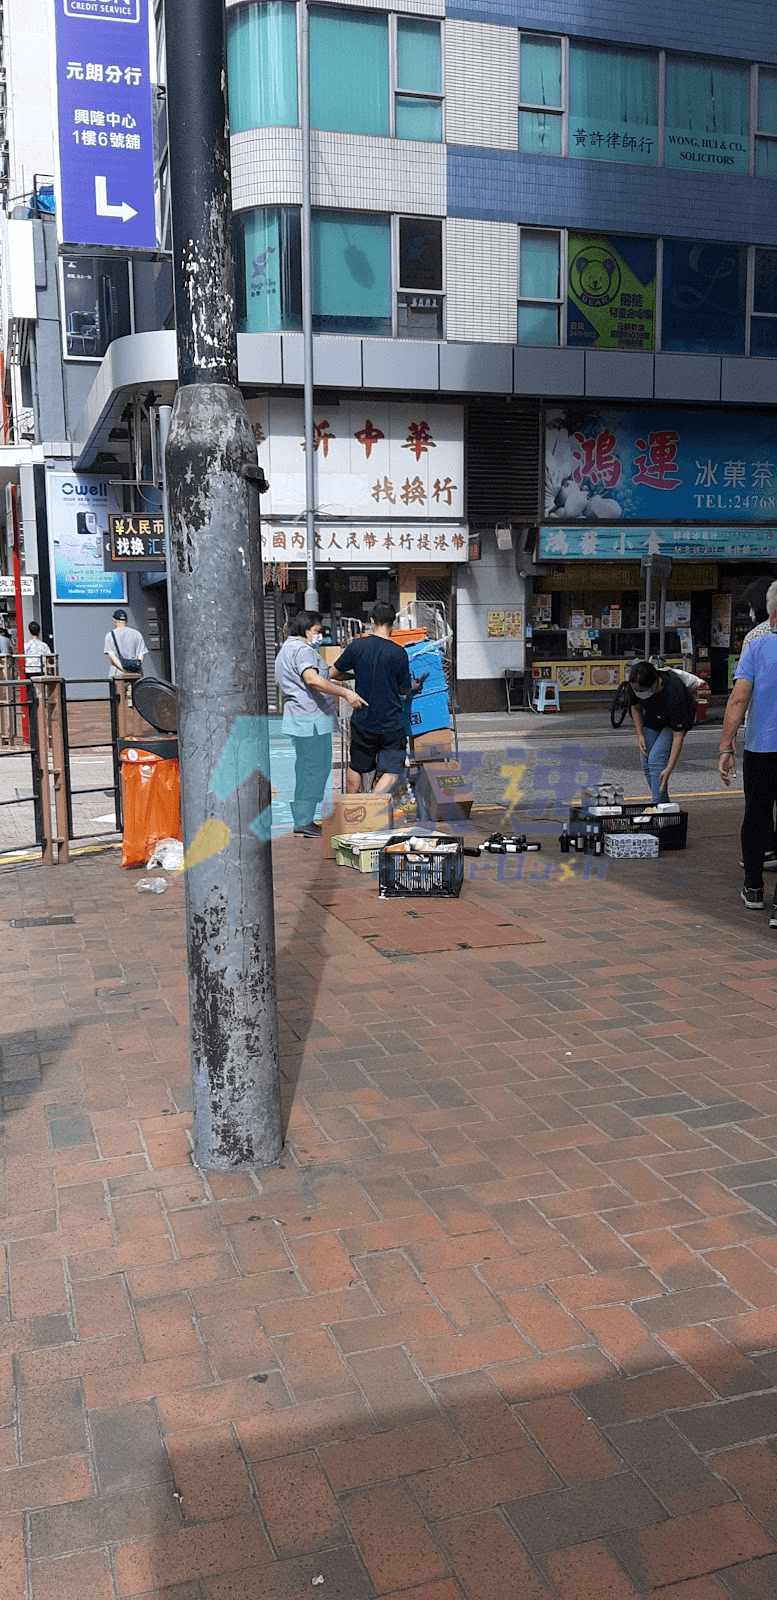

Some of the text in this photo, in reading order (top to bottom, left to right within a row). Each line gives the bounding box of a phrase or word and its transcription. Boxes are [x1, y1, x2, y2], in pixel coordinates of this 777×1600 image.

[70, 1, 99, 12] CREDIT
[100, 4, 132, 15] SERVICE
[65, 61, 143, 86] 元朗分行
[73, 108, 137, 130] 興隆中心
[71, 128, 141, 150] 1樓6號舖
[571, 127, 655, 155] 黃許律師行
[702, 139, 718, 149] HUI
[719, 140, 728, 150] &
[679, 152, 735, 166] SOLICITORS
[580, 294, 610, 307] BEAR
[300, 418, 437, 463] 新中華
[572, 428, 775, 491] 鴻運 冰菓茶
[371, 475, 458, 507] 找換行
[694, 494, 777, 510] TEL:24768
[116, 537, 145, 556] 找换
